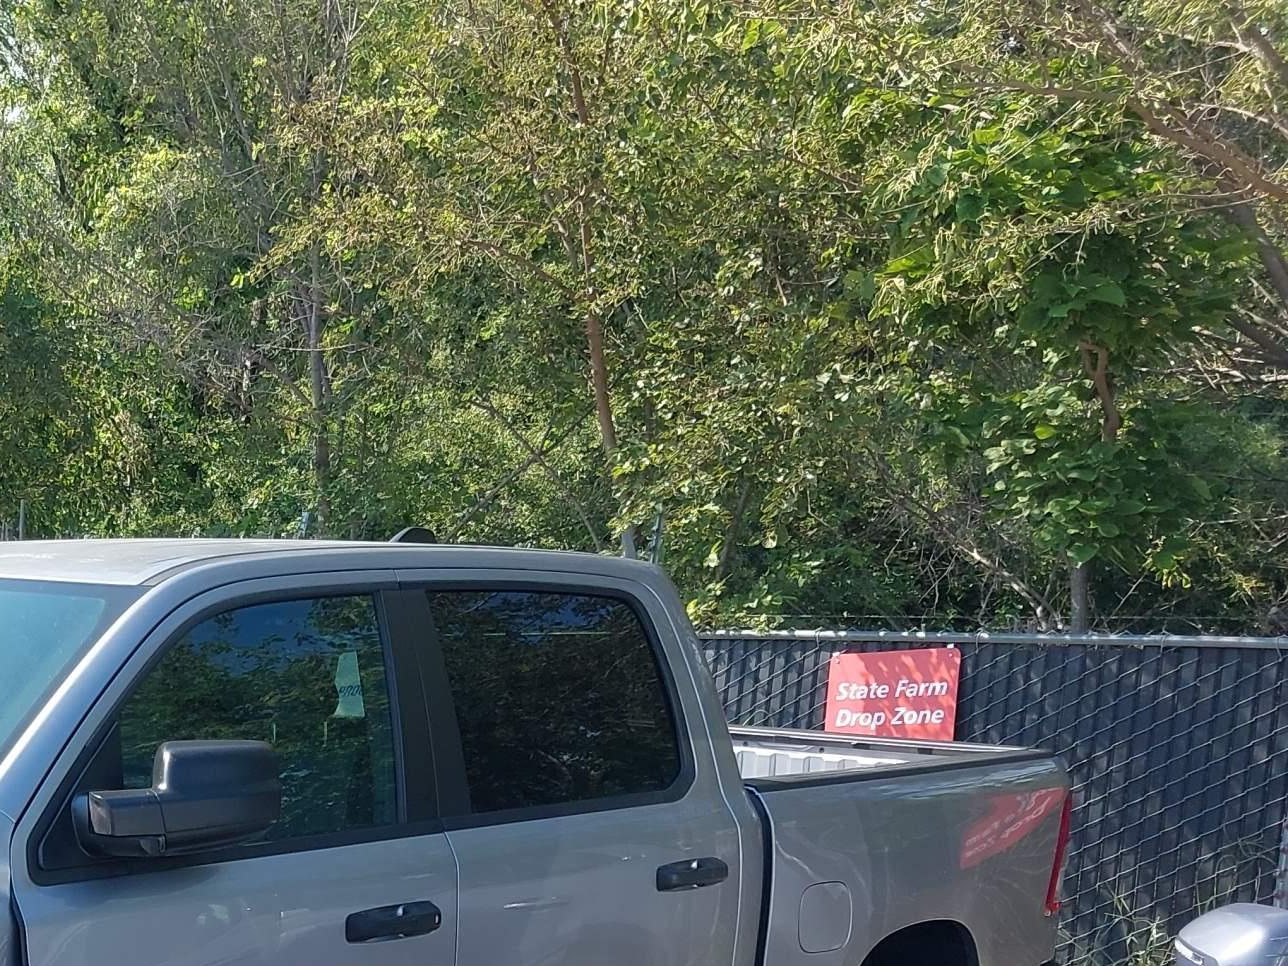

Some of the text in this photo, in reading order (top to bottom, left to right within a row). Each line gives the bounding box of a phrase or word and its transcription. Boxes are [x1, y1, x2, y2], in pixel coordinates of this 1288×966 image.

[835, 679, 948, 701] State Farm
[834, 706, 945, 731] Drop Zone
